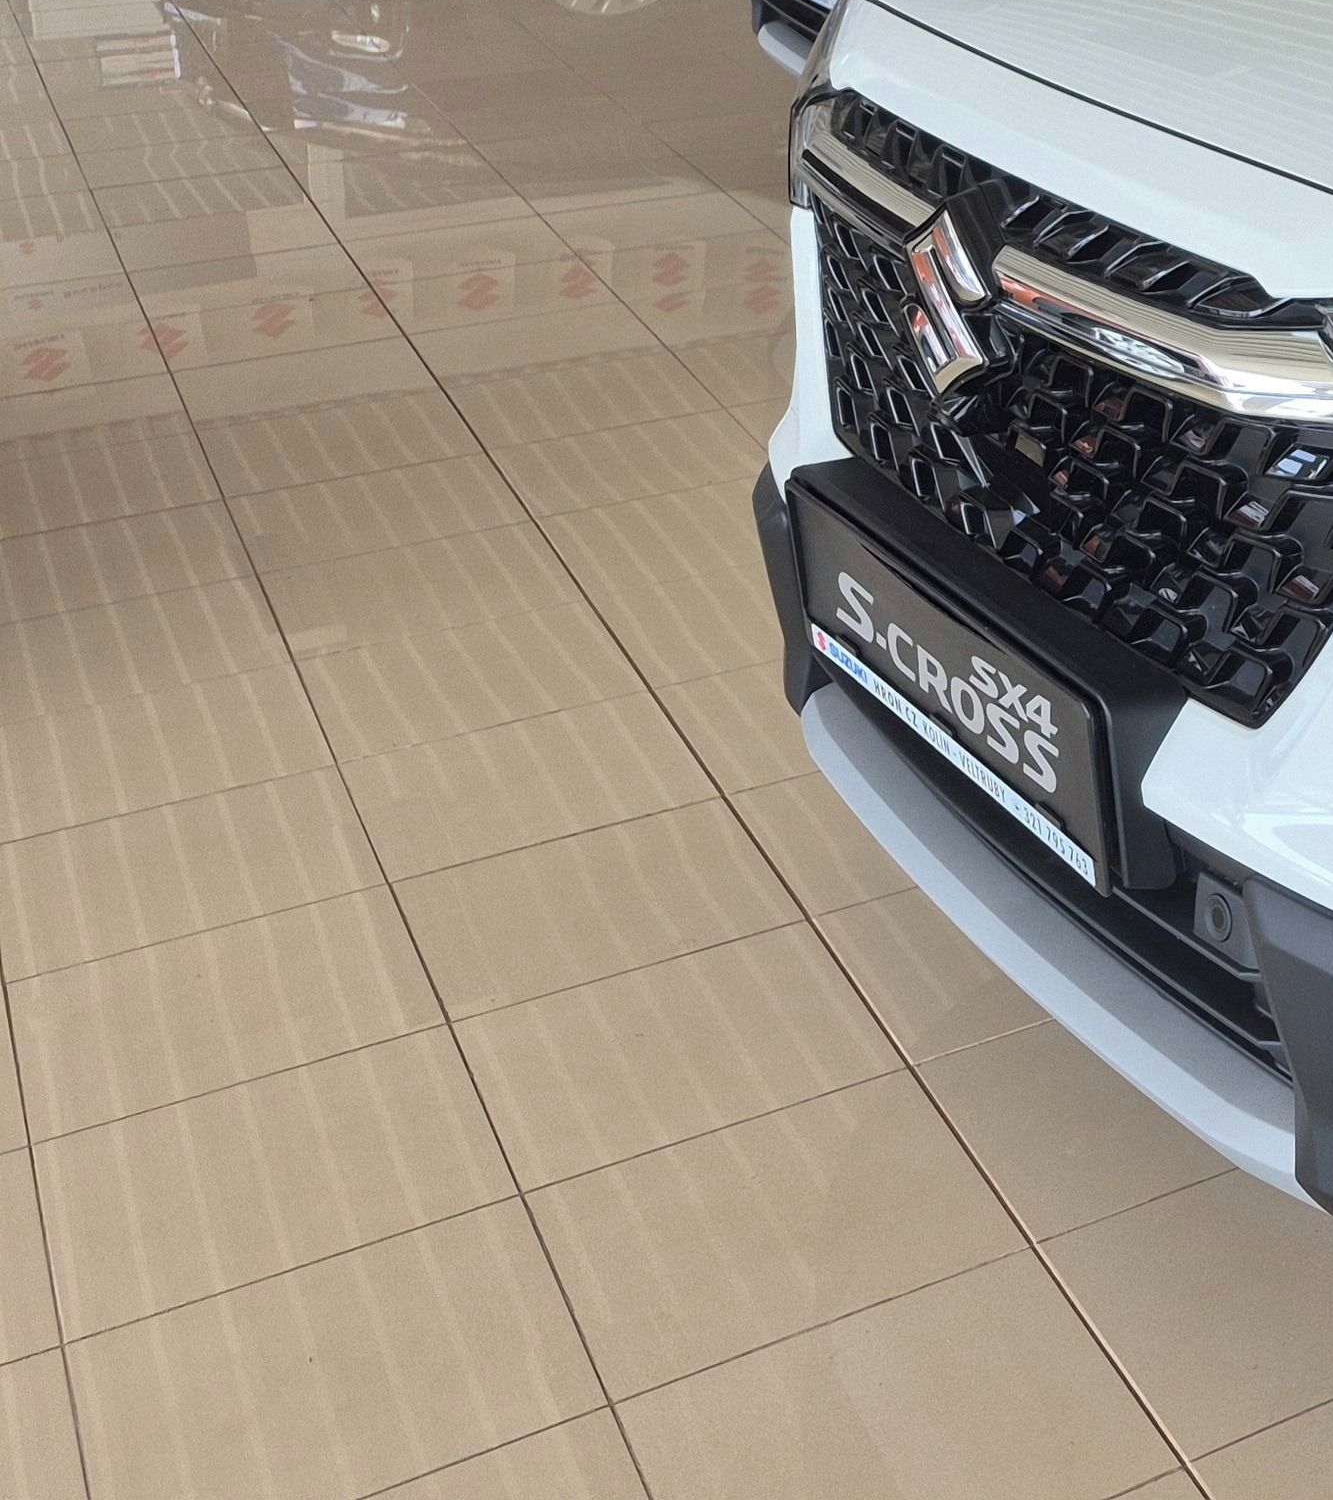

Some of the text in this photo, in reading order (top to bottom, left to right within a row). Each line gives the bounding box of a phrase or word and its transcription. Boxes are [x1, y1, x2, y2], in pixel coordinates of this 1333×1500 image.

[829, 642, 868, 684] SUZUKI
[873, 679, 902, 714] HRON
[905, 706, 918, 728] CZ
[959, 750, 1006, 803] VELTRUBY
[1024, 806, 1042, 836] 321
[1046, 825, 1066, 855] 795
[1069, 845, 1089, 876] 763
[969, 655, 1059, 736] SX4
